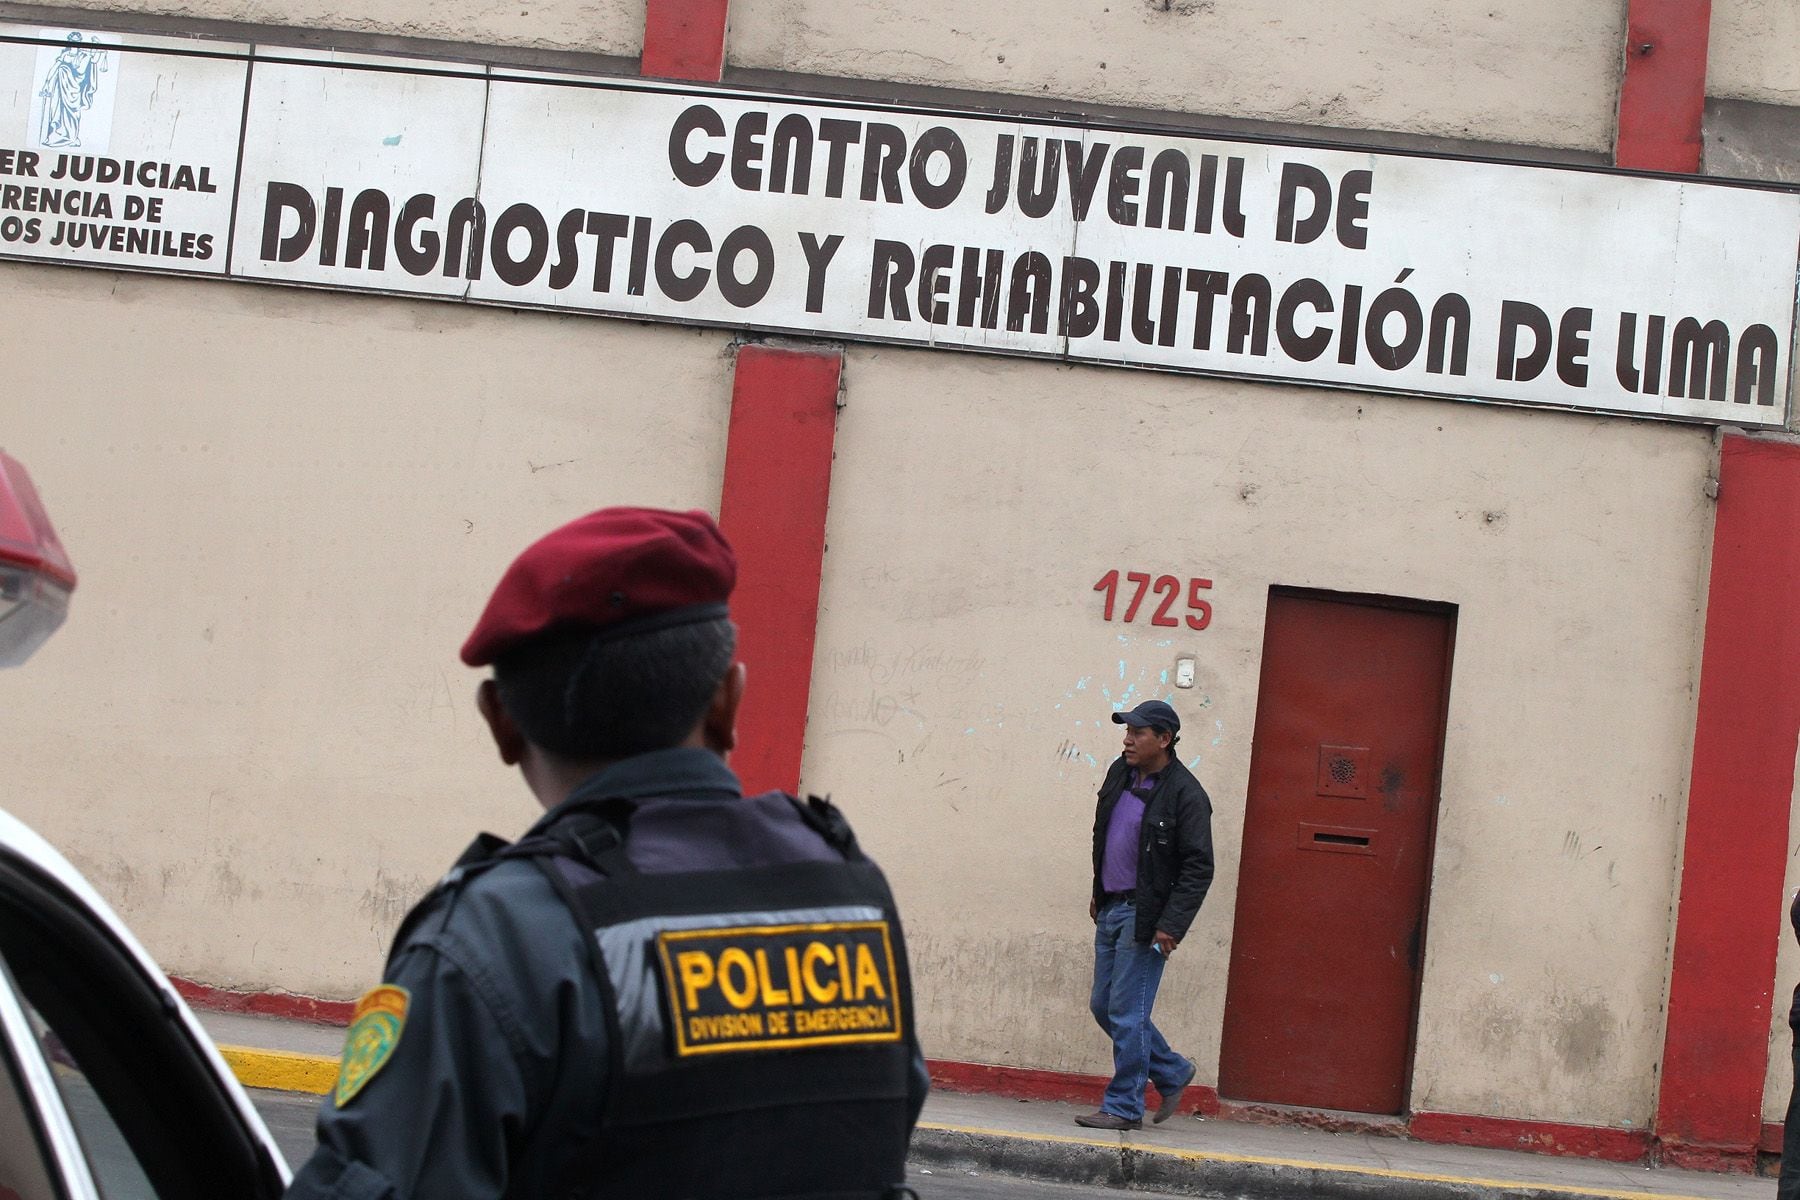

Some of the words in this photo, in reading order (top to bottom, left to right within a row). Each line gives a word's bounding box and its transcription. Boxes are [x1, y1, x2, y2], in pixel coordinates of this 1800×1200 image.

[50, 154, 217, 193] JUDICIAL
[669, 105, 968, 210] CENTRO
[985, 134, 1246, 239] JUVENIL
[1276, 162, 1373, 250] DE
[0, 183, 113, 219] RENCIA
[124, 195, 163, 223] DE
[50, 220, 214, 260] JUVENILES
[260, 181, 775, 308] DIAGNOSTICO
[798, 232, 844, 313] Y
[868, 239, 1471, 377] REHABILITACIÓN
[1496, 300, 1593, 388] DE
[1616, 312, 1778, 406] LIMA
[1094, 570, 1213, 630] 1725
[677, 941, 887, 1011] POLICIA
[689, 1013, 763, 1040] DIVISION
[768, 1009, 789, 1034] DE
[794, 1004, 890, 1033] EMERGENCIA
